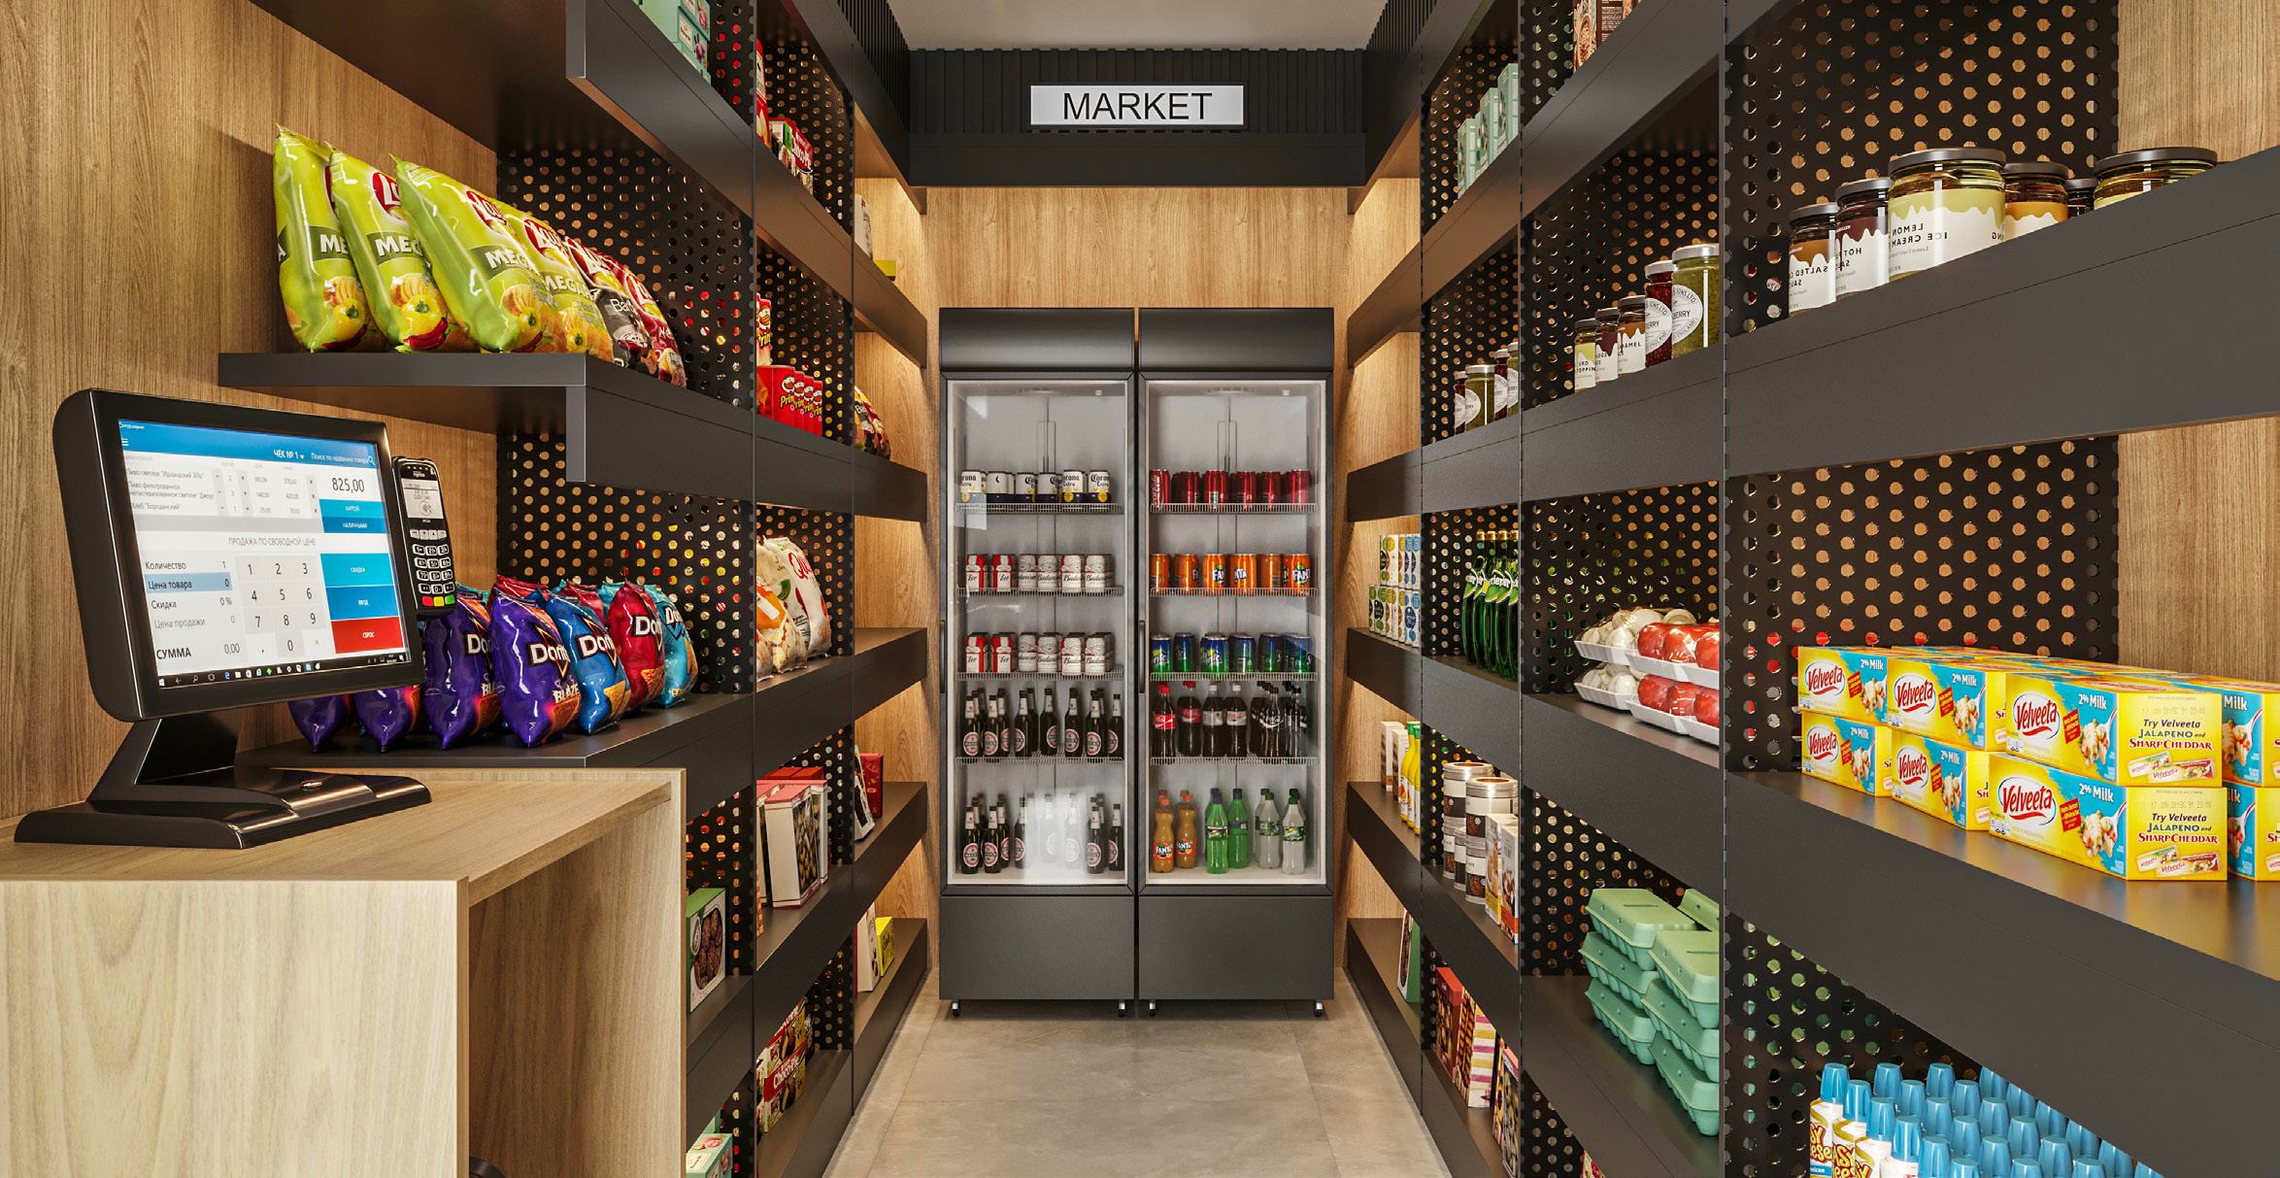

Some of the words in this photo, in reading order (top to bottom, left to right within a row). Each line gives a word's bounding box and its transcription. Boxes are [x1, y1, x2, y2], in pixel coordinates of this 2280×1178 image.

[1062, 92, 1213, 122] MARKET
[332, 477, 365, 493] 825,00
[228, 537, 259, 547] ПРОДАЖА
[260, 538, 267, 546] ПО
[267, 536, 302, 546] СВОБОДНОЙ
[145, 561, 187, 571] Количество
[248, 563, 254, 576] 1
[276, 563, 282, 575] 2
[303, 562, 309, 575] 3
[148, 580, 167, 592] Цена
[168, 579, 193, 591] товара
[224, 578, 230, 588] 0
[251, 591, 258, 602] 4
[279, 589, 286, 601] 5
[306, 588, 312, 600] 6
[151, 599, 177, 610] Скидка
[219, 597, 225, 606] 0
[225, 597, 233, 606] %
[154, 618, 176, 629] Цена
[177, 617, 206, 628] продажи
[255, 616, 261, 628] 7
[283, 615, 290, 627] 8
[310, 612, 317, 625] 9
[156, 649, 192, 660] СУММА
[224, 643, 241, 656] 0,00
[287, 639, 294, 651] 0
[1869, 659, 1884, 670] Milk
[1808, 666, 1843, 692] Velveeta
[1962, 674, 1977, 687] Milk
[1897, 680, 1934, 708] Velveeta
[2089, 695, 2107, 710] Milk
[2224, 694, 2248, 711] Milk
[2017, 699, 2058, 730] Velveeta
[2143, 719, 2159, 729] Try
[2160, 719, 2201, 728] Velveeta
[2138, 728, 2193, 739] JALAPENO
[1809, 732, 1837, 755] Velveeta
[2128, 738, 2163, 749] SHARP
[2163, 739, 2214, 751] CHEDDAR
[1899, 753, 1927, 779] Velveeta
[2002, 785, 2053, 813] Velveeta
[2078, 783, 2092, 795] 2%
[2093, 785, 2114, 803] Milk
[2152, 813, 2167, 823] Try
[2168, 813, 2207, 822] Velveeta
[2147, 822, 2200, 833] JALAPENO
[2138, 832, 2172, 844] SHARP
[2171, 833, 2219, 844] CHEDDAR
